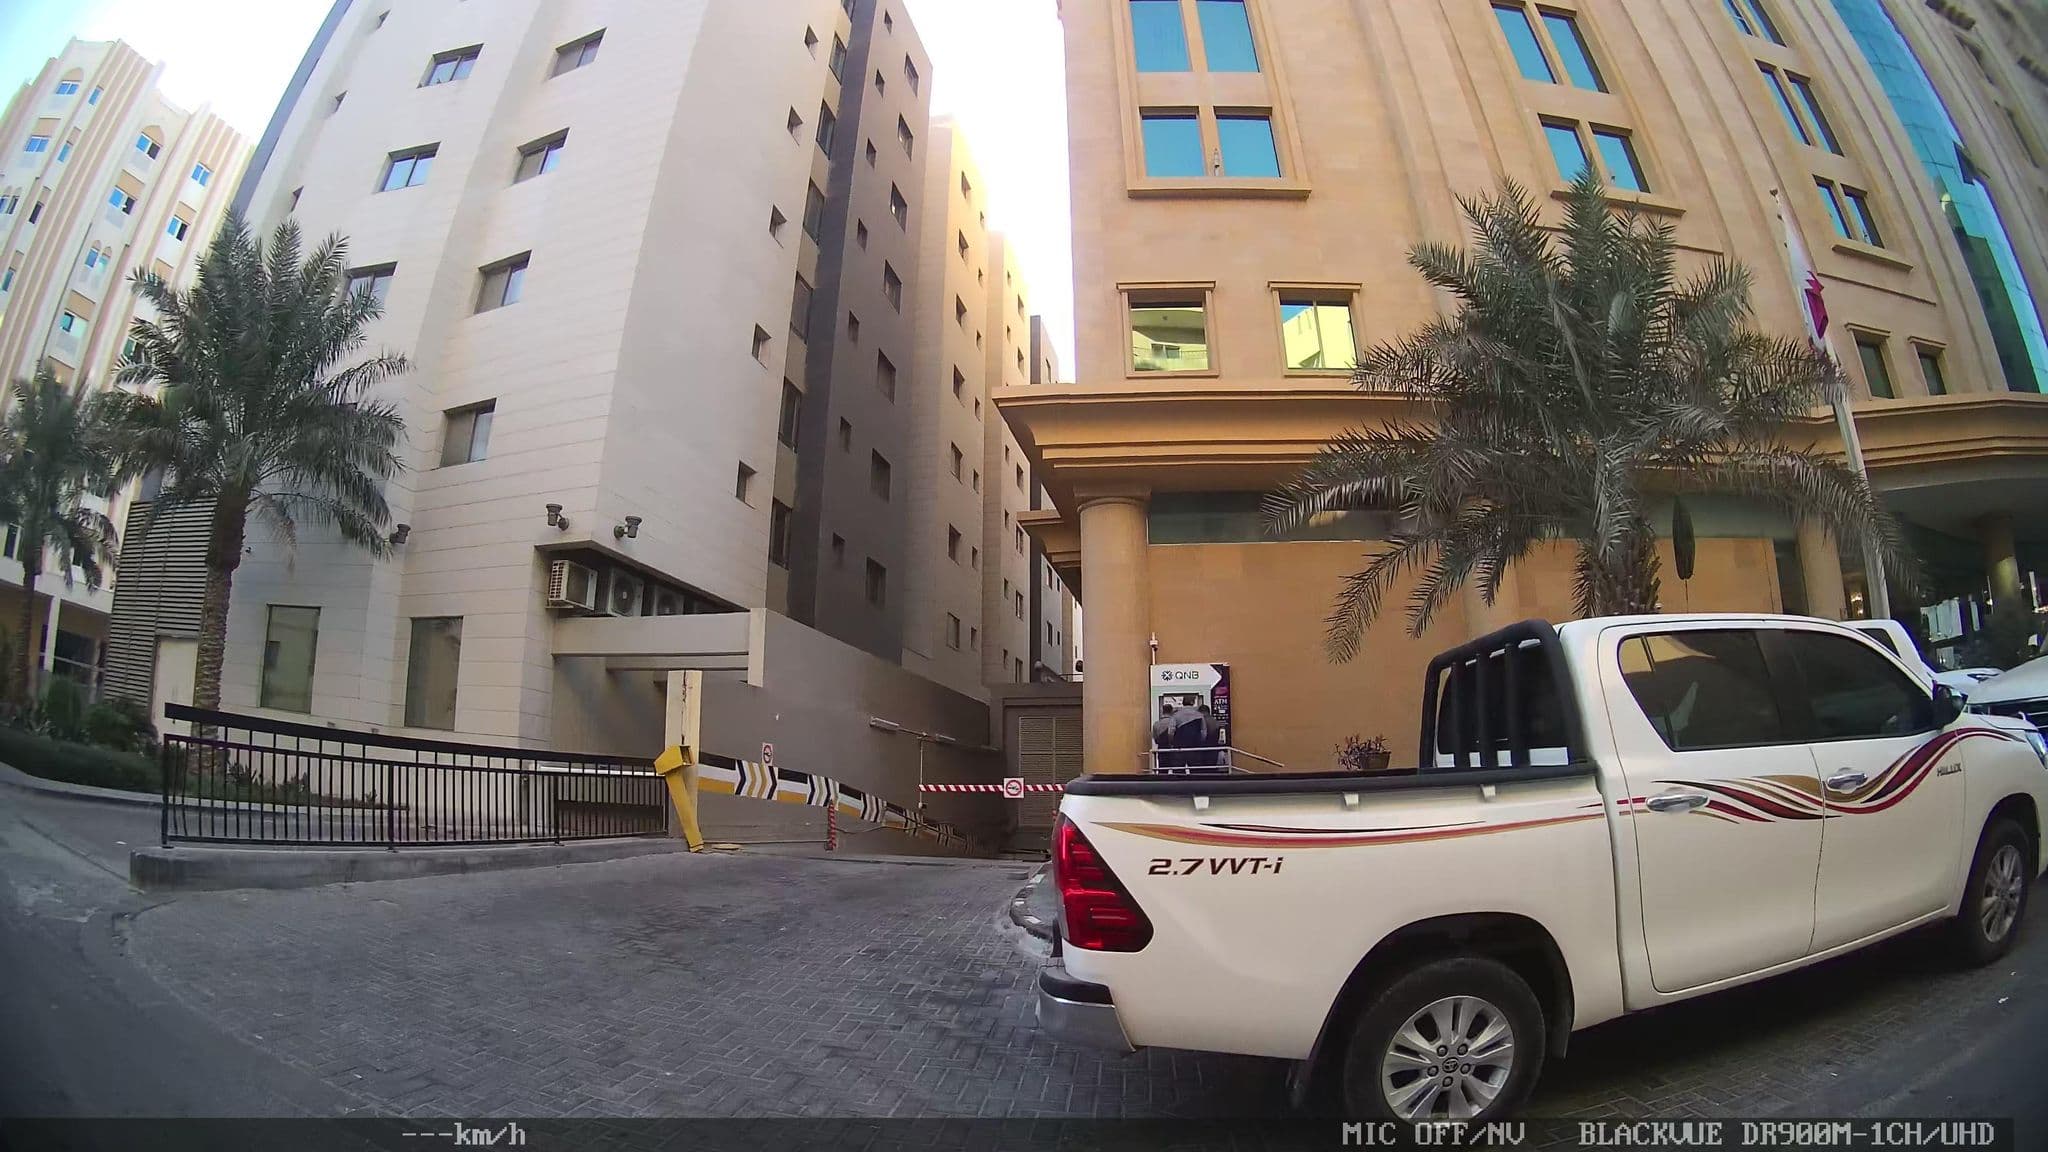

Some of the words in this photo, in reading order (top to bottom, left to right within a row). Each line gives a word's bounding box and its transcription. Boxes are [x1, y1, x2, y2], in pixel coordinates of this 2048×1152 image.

[1175, 671, 1199, 680] QNB
[1148, 858, 1204, 875] 2.7
[1210, 857, 1283, 875] VVT-i
